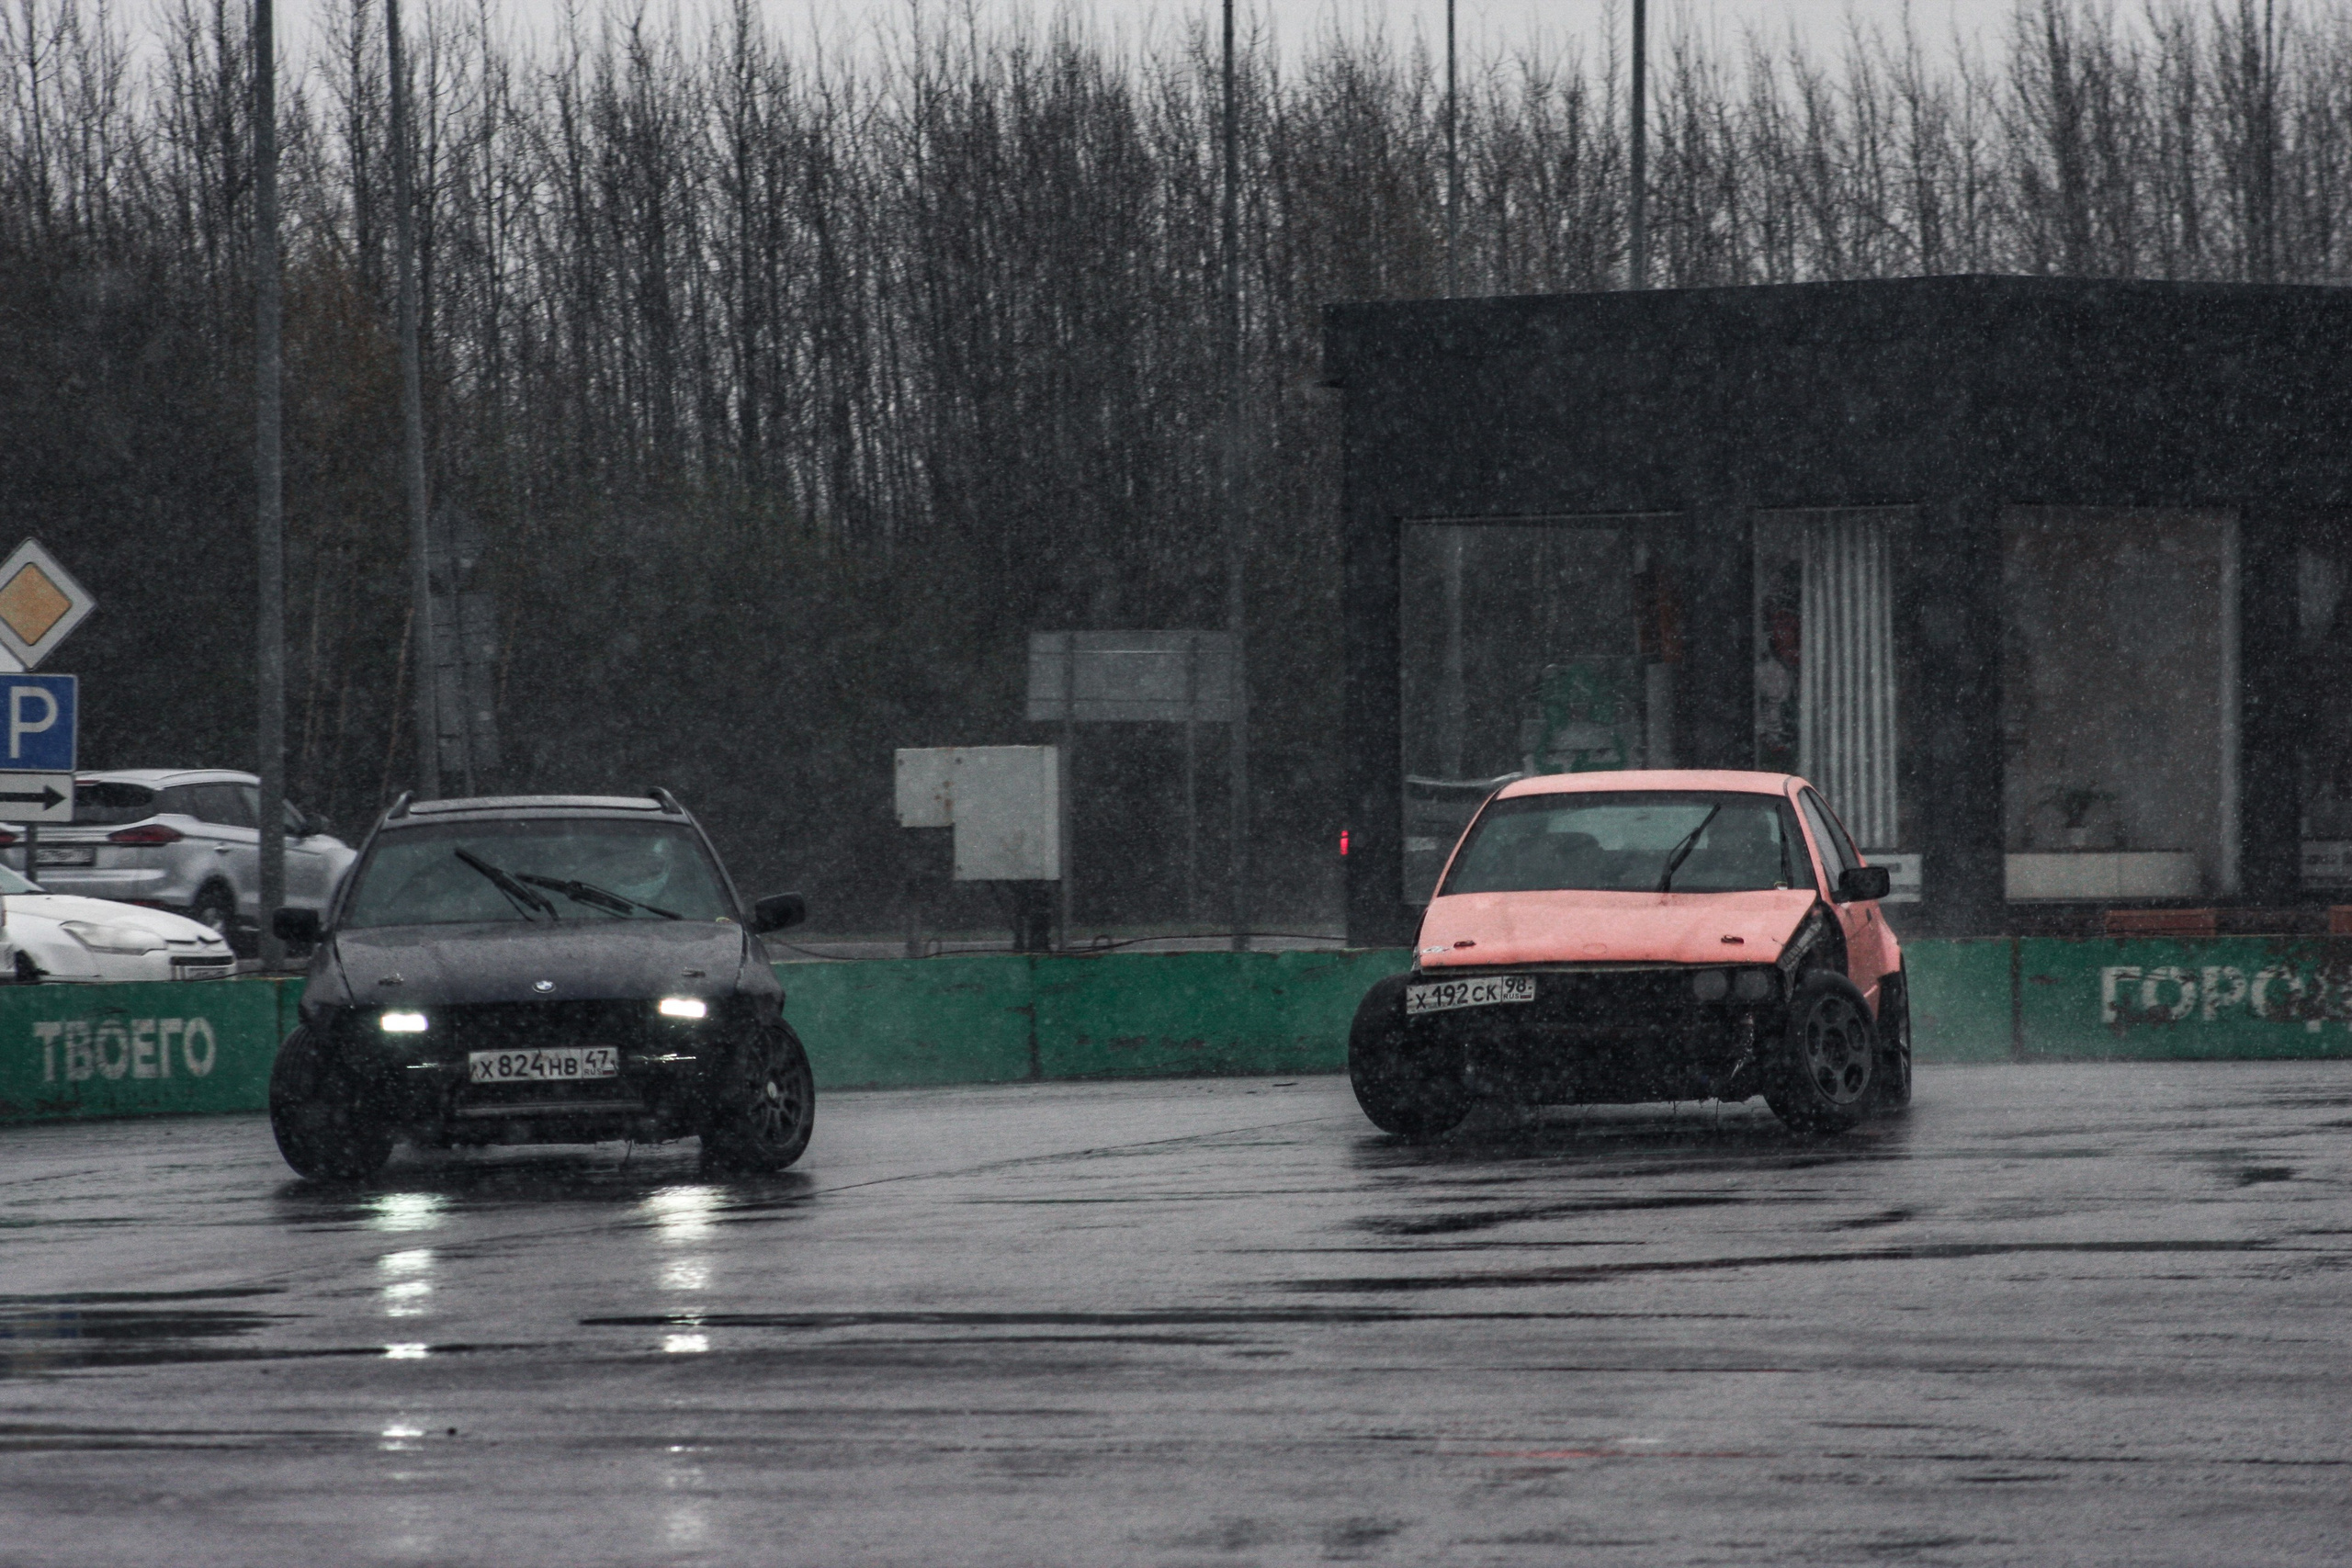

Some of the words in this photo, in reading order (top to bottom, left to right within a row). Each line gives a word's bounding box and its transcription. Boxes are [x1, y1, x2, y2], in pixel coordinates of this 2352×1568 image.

[10, 686, 58, 759] P
[1505, 977, 1527, 994] 98
[32, 1017, 216, 1082] ТВОЕГО
[585, 1050, 608, 1068] 47
